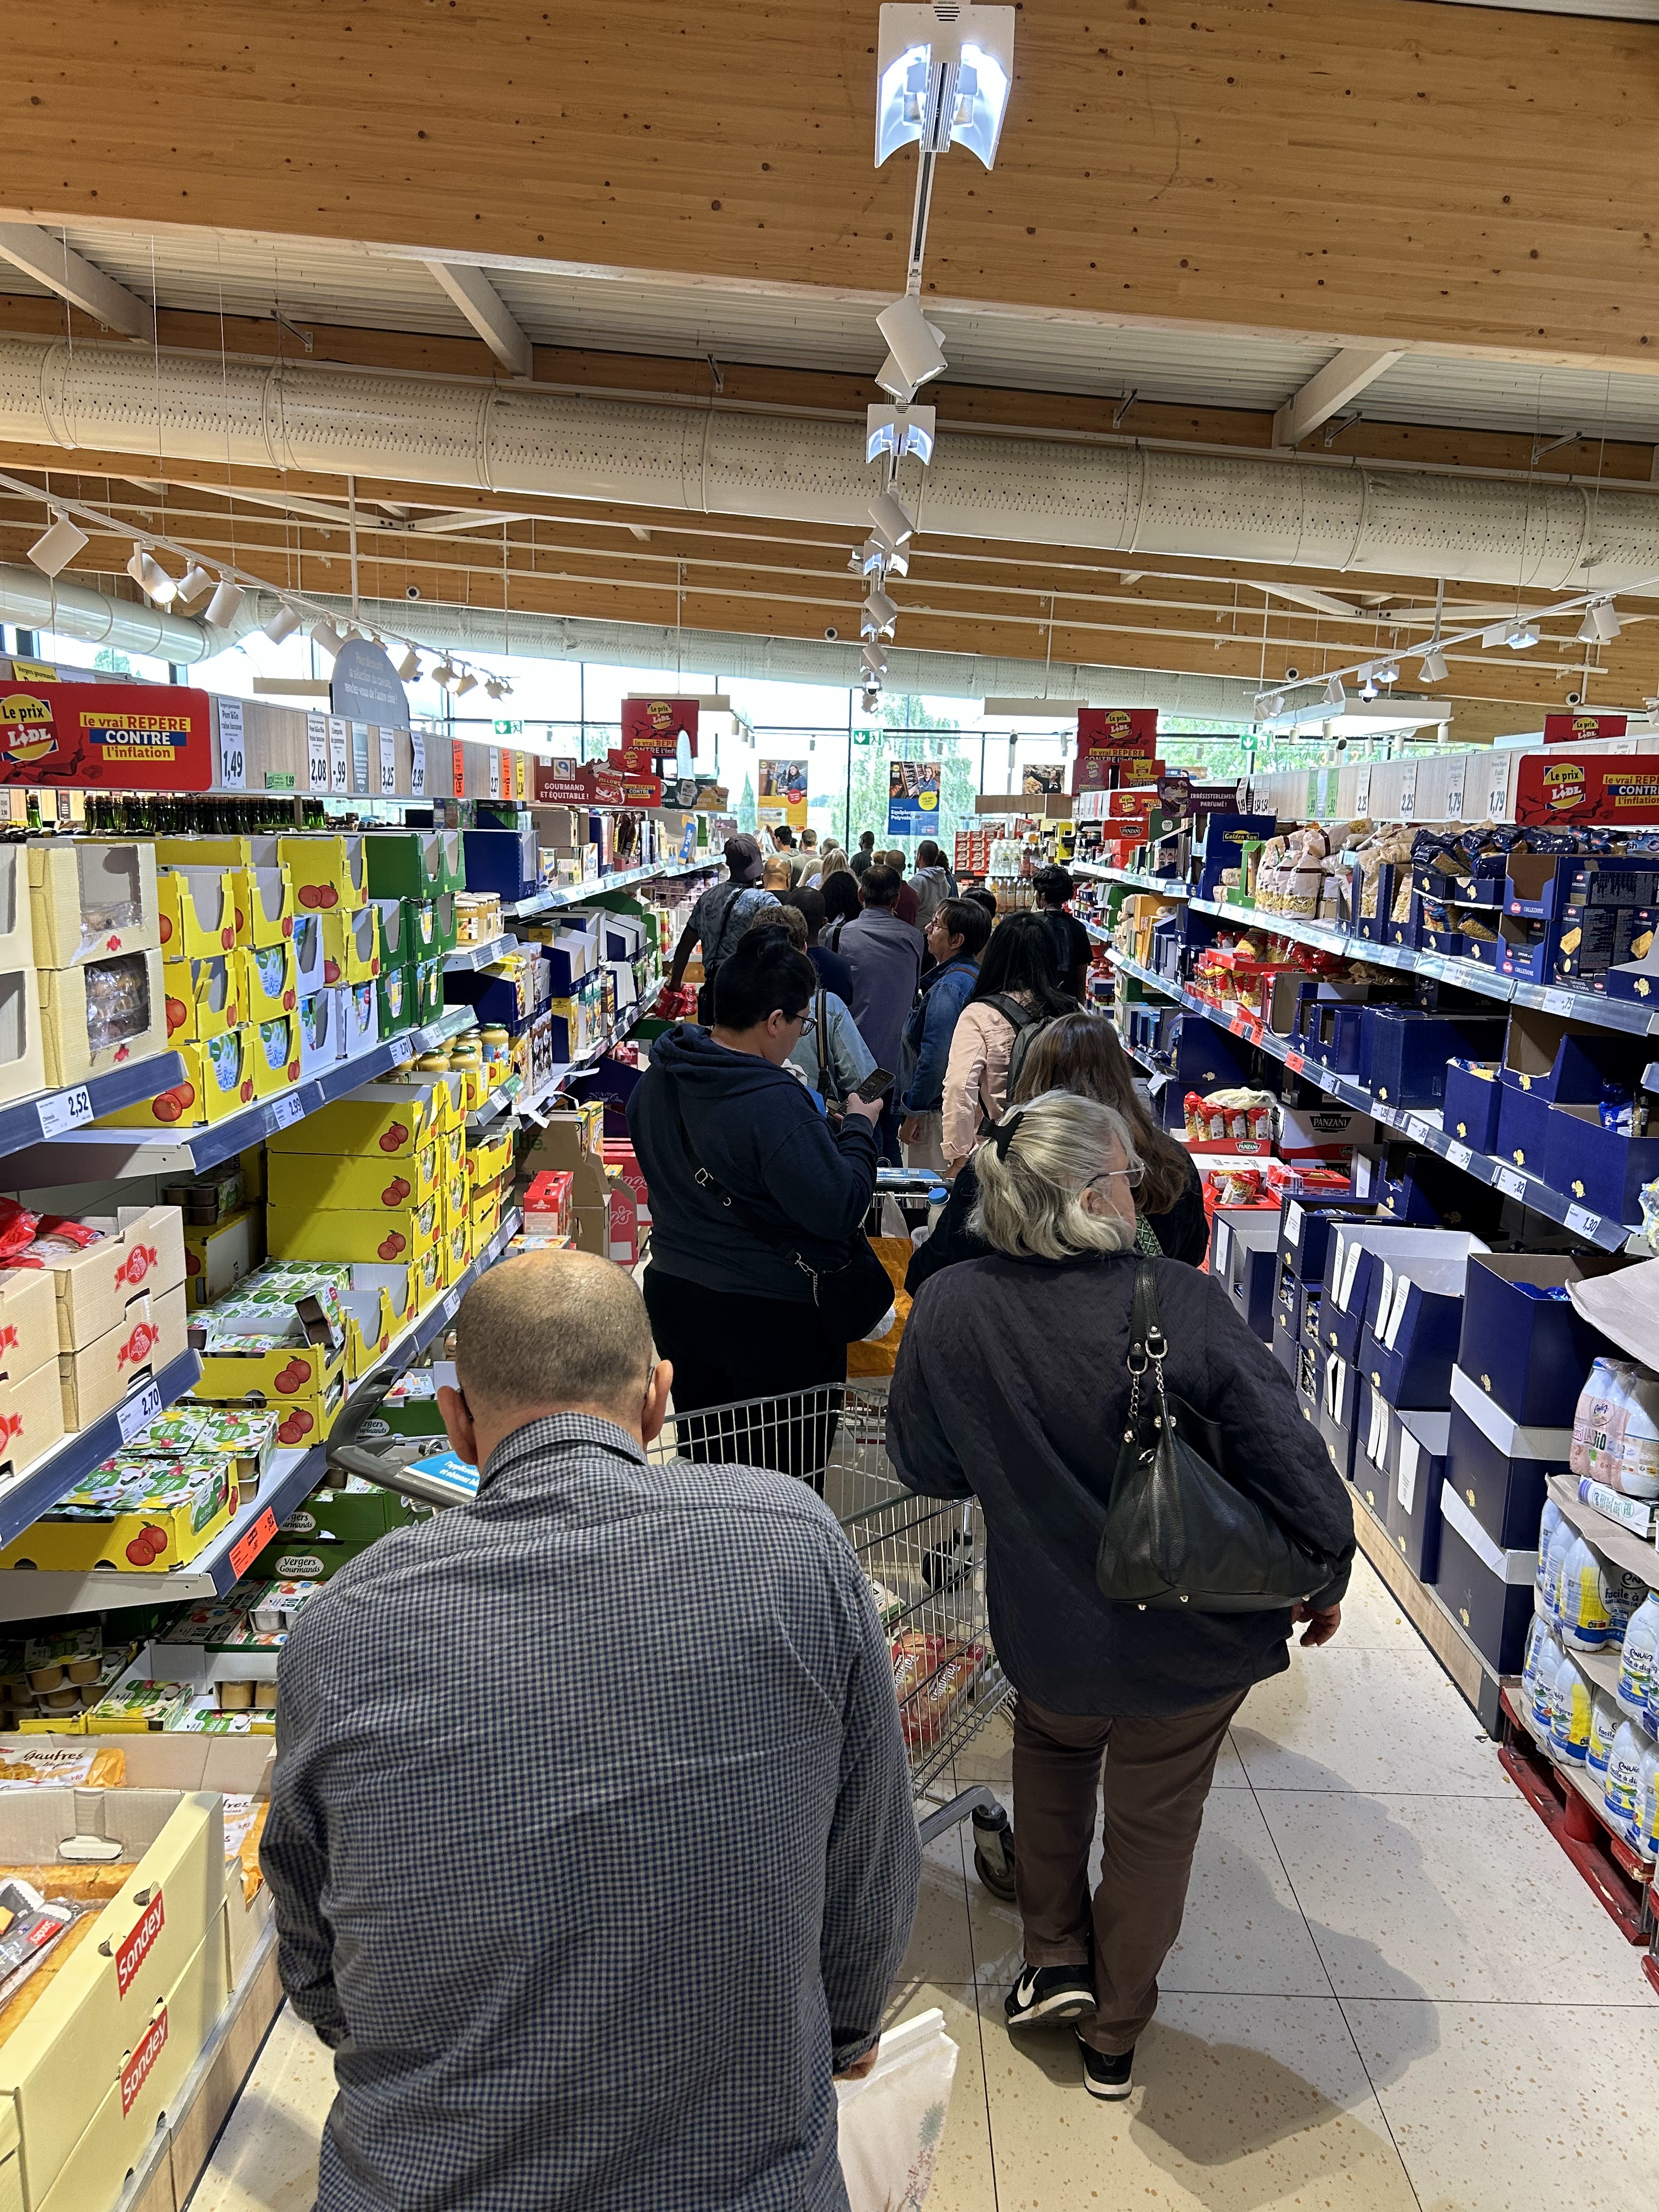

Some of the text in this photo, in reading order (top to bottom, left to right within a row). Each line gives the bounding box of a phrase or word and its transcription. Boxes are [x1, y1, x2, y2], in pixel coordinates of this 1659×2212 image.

[3, 703, 44, 722] Le prix
[1116, 714, 1127, 723] prix
[83, 714, 188, 731] le vrai REPÈRE
[1583, 721, 1595, 729] prix
[105, 730, 171, 745] CONTRE
[223, 750, 242, 781] 1,49
[311, 758, 327, 785] 2,08
[1550, 770, 1578, 782] Le prix
[1605, 776, 1633, 784] le vrai
[544, 783, 585, 791] GOURMAND
[549, 790, 585, 800] ÉQUITABLE
[1448, 792, 1462, 813] 1,79
[1490, 791, 1505, 814] 1,79
[68, 1092, 89, 1118] 2,52
[1313, 1118, 1346, 1127] PANZANI
[1583, 1216, 1598, 1232] 1,30
[142, 1388, 159, 1416] 2,70
[279, 1565, 320, 1573] Gourmands
[284, 1557, 316, 1567] Vergers
[1605, 1588, 1629, 1599] Facile
[119, 1899, 163, 1987] Sondey
[123, 2016, 167, 2106] Sondey
